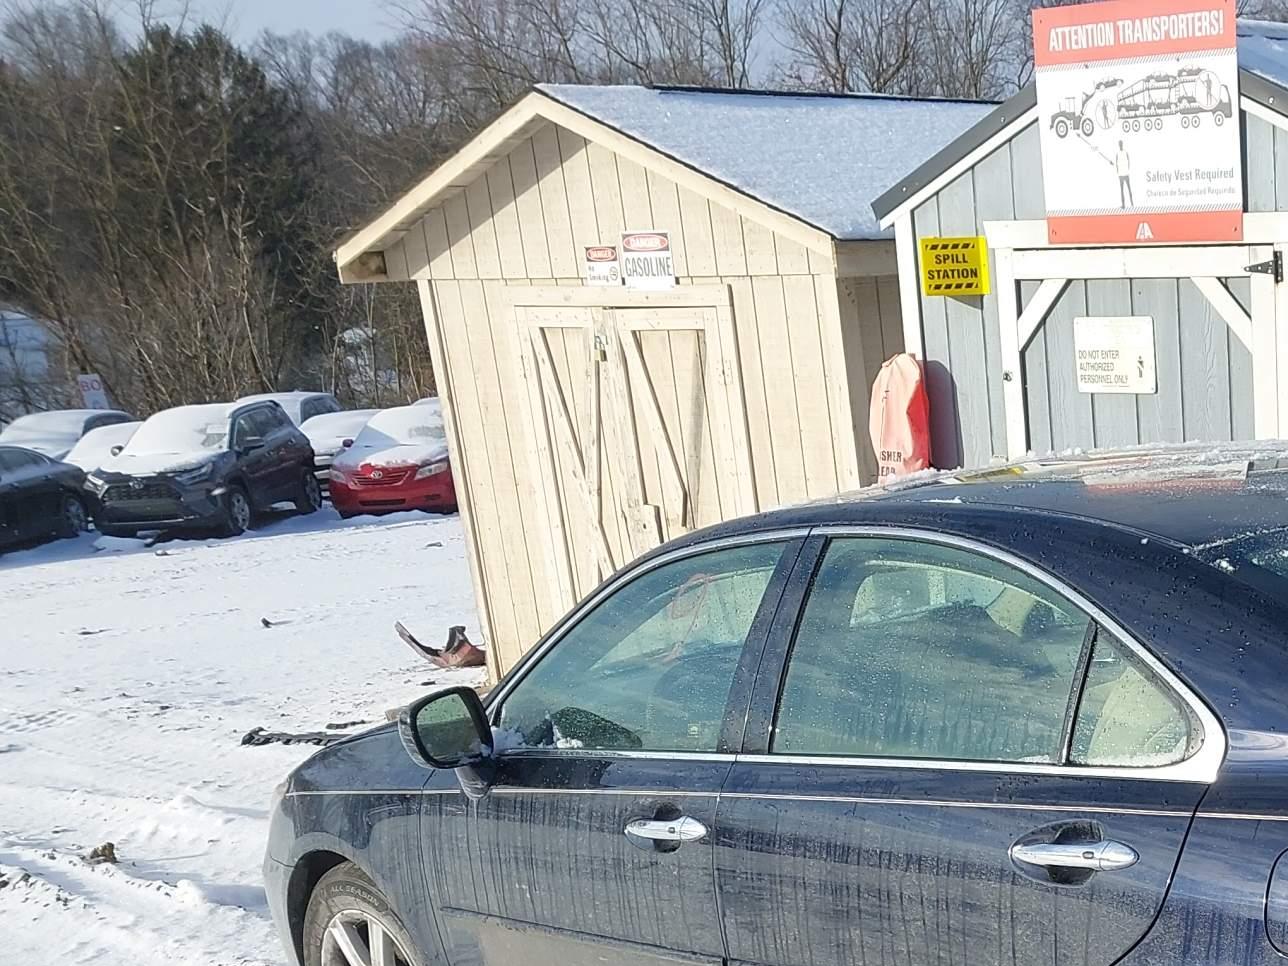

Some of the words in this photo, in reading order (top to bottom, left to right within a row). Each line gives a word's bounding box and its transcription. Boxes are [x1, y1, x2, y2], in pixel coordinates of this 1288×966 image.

[1048, 22, 1115, 52] ATTENTION
[1116, 10, 1224, 45] TRANSPORTERS!
[1145, 170, 1172, 184] Safety
[1174, 169, 1193, 181] Vest
[1195, 168, 1234, 183] Required
[934, 253, 968, 265] SPILL
[624, 256, 672, 277] GASOLINE
[927, 268, 978, 280] STATION
[1078, 350, 1087, 360] DO
[1088, 350, 1099, 360] NOT
[1101, 350, 1120, 360] ENTER
[1079, 362, 1115, 371] AUTHORIZED
[1080, 374, 1112, 384] PERSONNEL
[1113, 374, 1129, 384] ONLY
